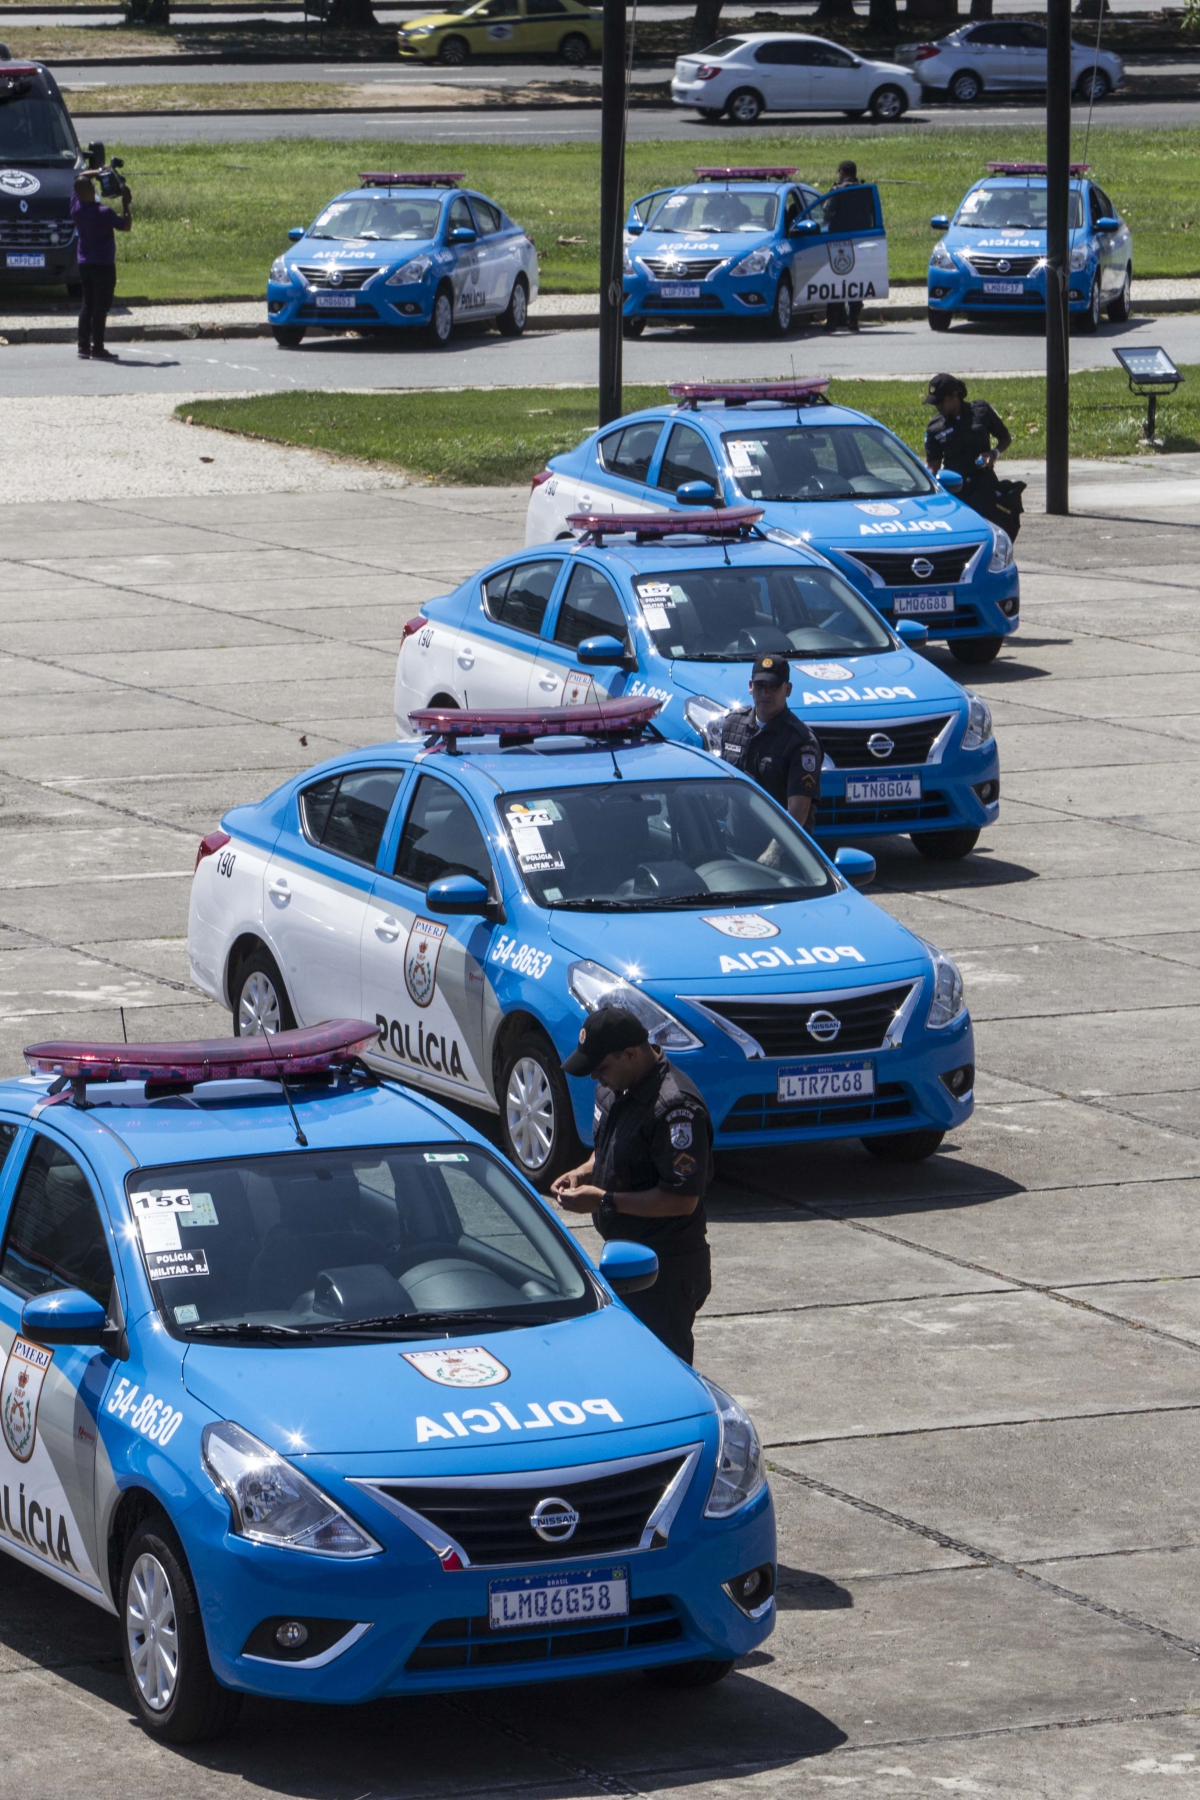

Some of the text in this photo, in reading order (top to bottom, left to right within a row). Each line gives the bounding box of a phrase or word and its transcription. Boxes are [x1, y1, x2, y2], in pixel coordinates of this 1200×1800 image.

[807, 280, 876, 300] POLÍCIA
[899, 597, 947, 611] LMQ6G88
[418, 629, 434, 648] 190
[853, 782, 912, 799] LTN8G04
[512, 814, 551, 824] 179
[217, 850, 236, 878] 190
[526, 853, 553, 862] POLÍCIA
[415, 921, 444, 937] PMERJ
[491, 934, 553, 979] 54-8653
[811, 1022, 839, 1031] NISSAN
[376, 1013, 469, 1082] POLÍCIA
[786, 1072, 863, 1097] LTR7C68
[136, 1195, 191, 1209] 156
[156, 1252, 194, 1264] POLÍCIA
[150, 1265, 189, 1278] MILITAR
[196, 1264, 208, 1273] RJ
[14, 1341, 49, 1367] PMERJ
[409, 1348, 480, 1359] PMERJ
[107, 1377, 183, 1446] 54-8630
[0, 1482, 80, 1573] LÍCIA
[537, 1514, 577, 1526] NISSAN
[547, 1578, 569, 1586] BRASIL
[503, 1584, 611, 1621] LMQ6G58
